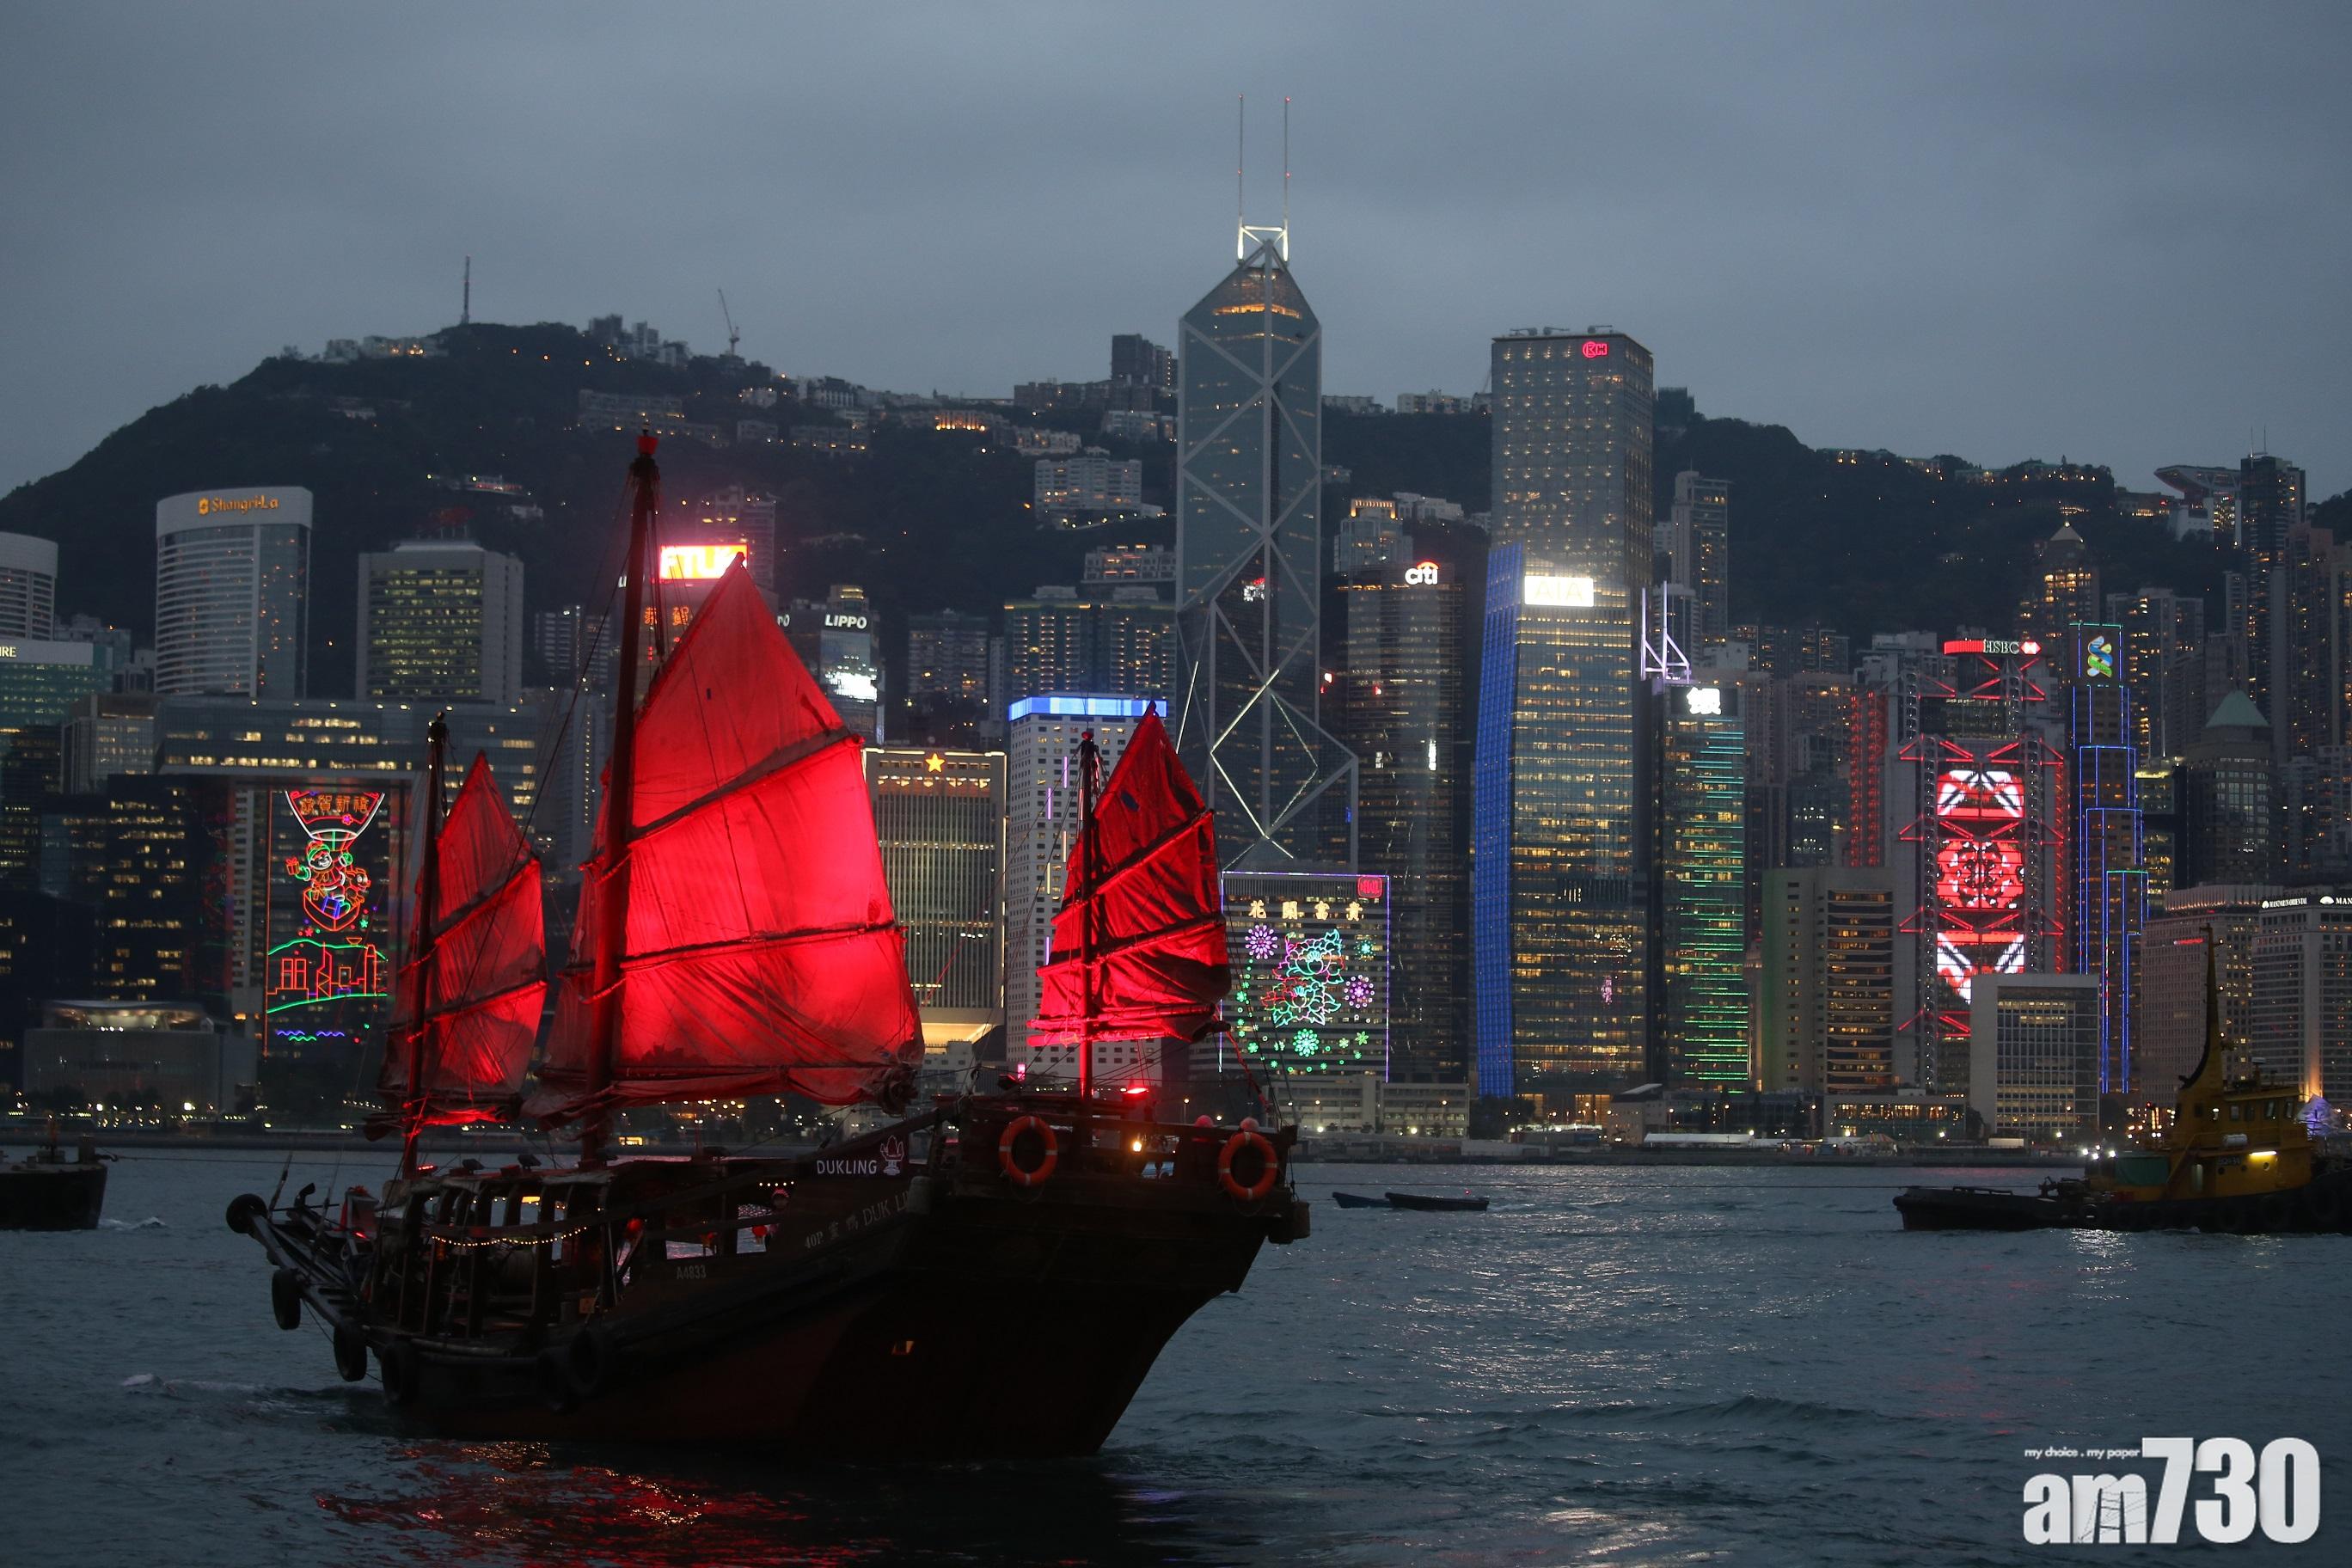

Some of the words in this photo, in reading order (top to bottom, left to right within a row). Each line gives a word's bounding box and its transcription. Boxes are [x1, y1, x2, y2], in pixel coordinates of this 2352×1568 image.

[212, 495, 279, 514] Shangri-La
[1405, 564, 1438, 585] citi
[1534, 579, 1583, 602] AIA
[825, 614, 867, 629] LIPPO
[1983, 642, 2019, 654] HSBC
[817, 1160, 878, 1175] DUKLING
[862, 1199, 891, 1227] DUK
[677, 1265, 707, 1280] A4833
